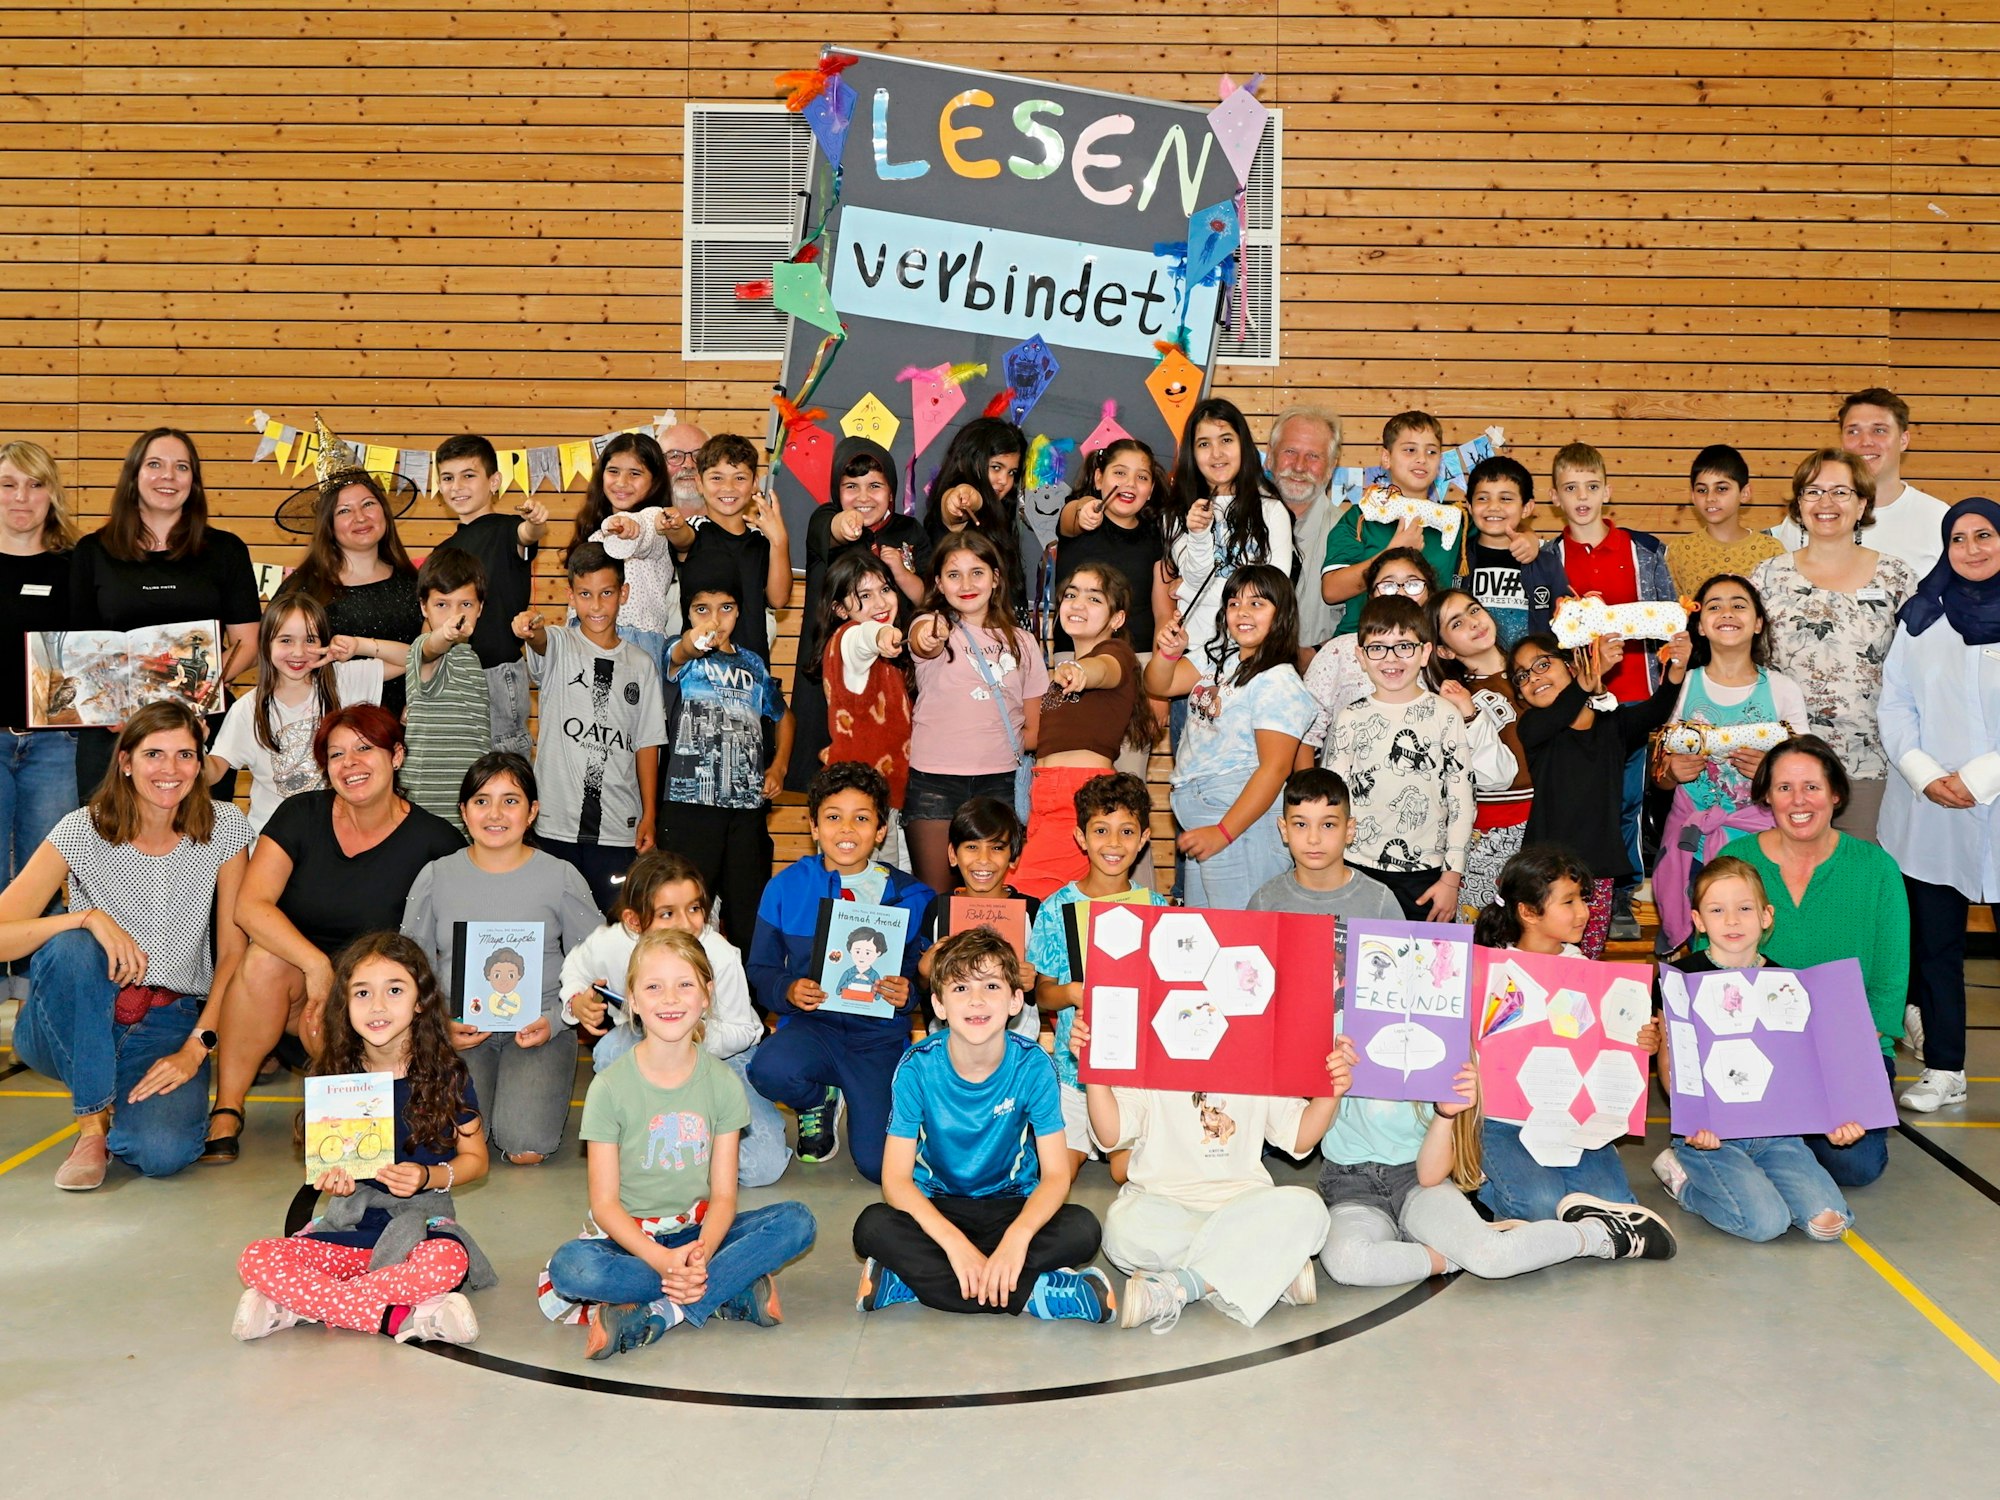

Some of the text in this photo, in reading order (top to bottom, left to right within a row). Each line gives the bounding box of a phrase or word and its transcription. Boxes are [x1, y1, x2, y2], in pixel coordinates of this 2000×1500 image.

[872, 87, 1213, 217] LESEN
[853, 240, 1166, 335] verbindet
[563, 717, 634, 753] QATAR
[580, 741, 614, 756] AIRWAYS
[838, 911, 871, 924] Hannah
[874, 917, 902, 928] Arendt
[327, 1083, 374, 1094] Freunde
